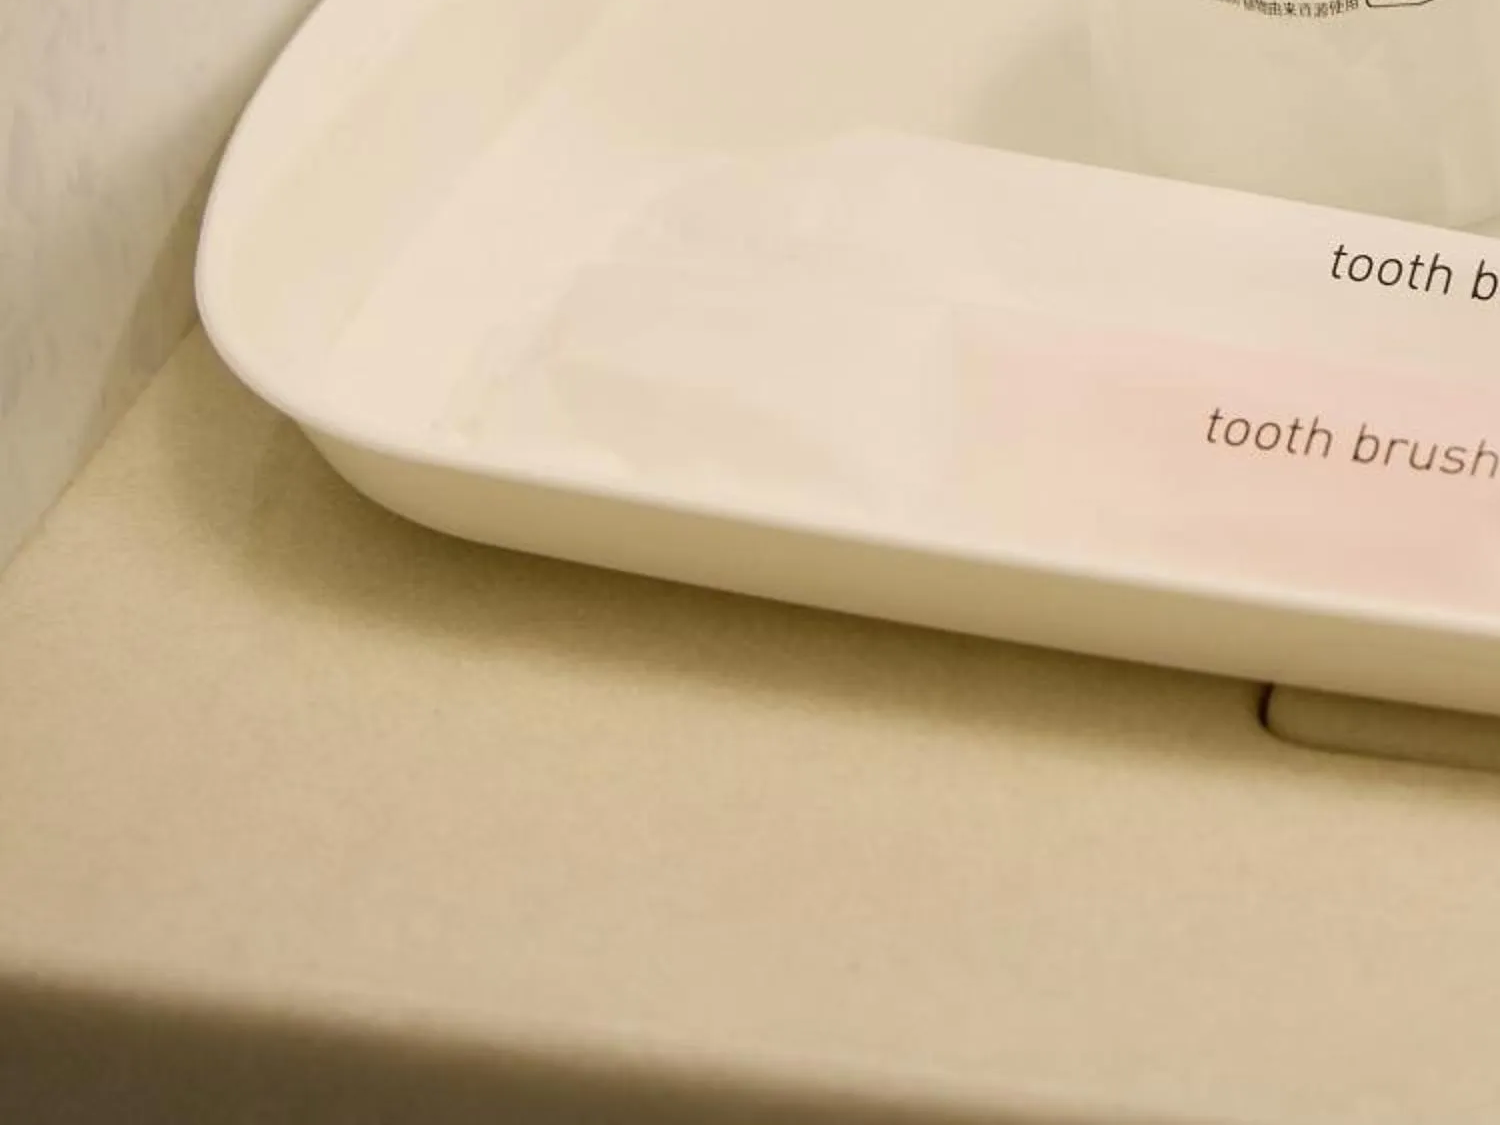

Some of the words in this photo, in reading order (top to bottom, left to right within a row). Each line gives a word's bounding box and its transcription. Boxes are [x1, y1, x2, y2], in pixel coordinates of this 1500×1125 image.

[1330, 243, 1453, 295] tooth
[1205, 407, 1333, 458] tooth
[1351, 422, 1500, 479] brush
